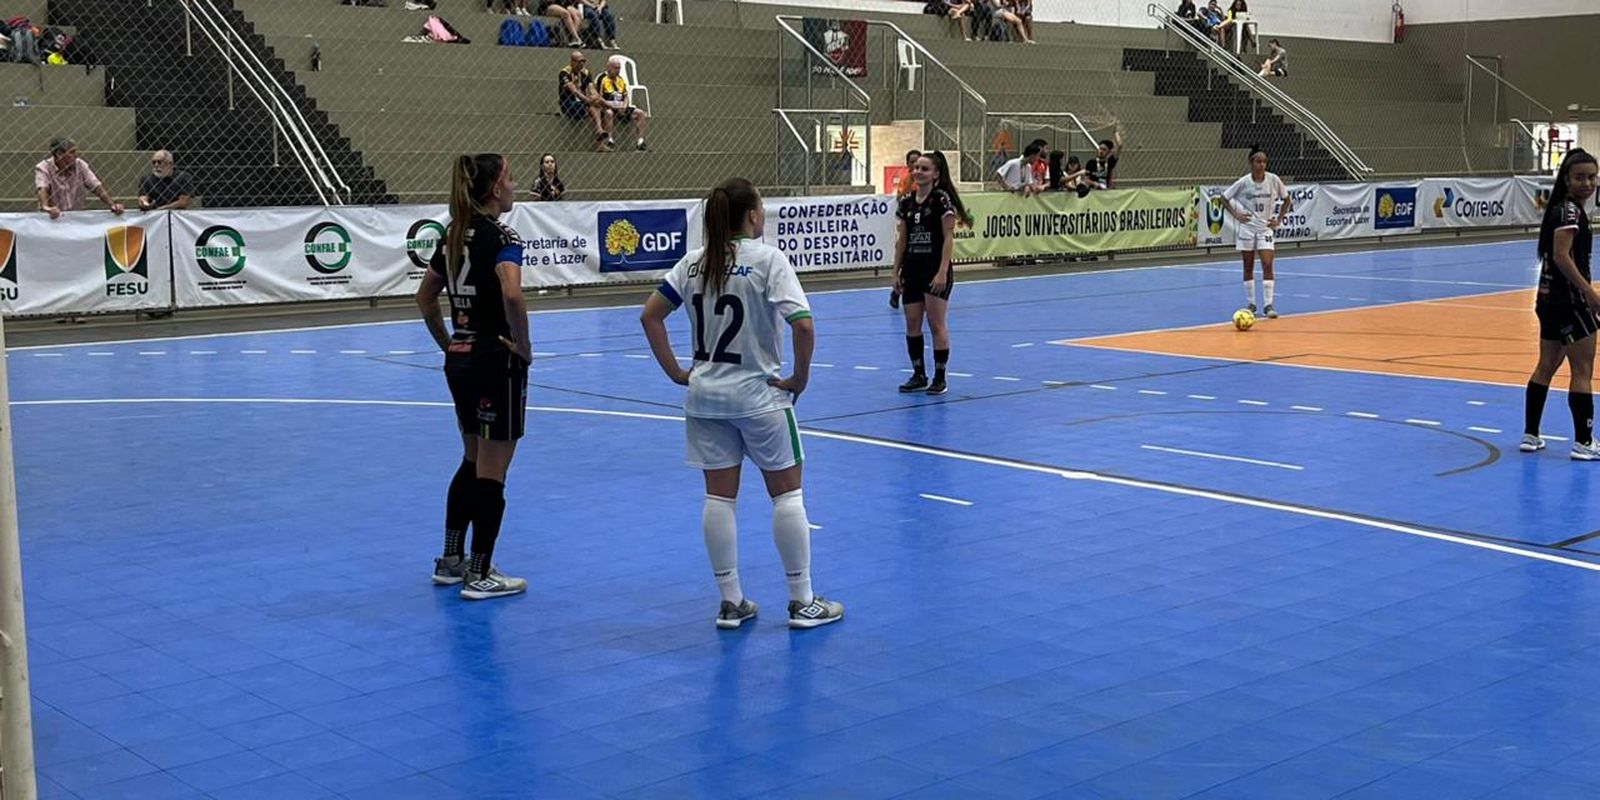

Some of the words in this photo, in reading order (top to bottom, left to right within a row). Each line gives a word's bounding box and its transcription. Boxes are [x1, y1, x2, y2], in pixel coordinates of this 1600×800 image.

[778, 200, 888, 219] CONFEDERAÇÃO
[1394, 203, 1414, 217] GDF
[1455, 197, 1504, 218] Correios
[914, 212, 921, 224] 9
[983, 215, 1021, 239] JOGOS
[1025, 208, 1117, 237] UNIVERSITÁRIOS
[1119, 207, 1186, 232] BRASILEIROS
[777, 219, 859, 235] BRASILEIRA
[304, 242, 335, 254] CONFAE
[521, 236, 568, 250] cretaria
[572, 236, 587, 249] de
[642, 232, 682, 252] GDF
[778, 238, 798, 252] DO
[804, 233, 876, 250] DESPORTO
[195, 246, 229, 258] CONFAE
[542, 256, 549, 265] e
[554, 252, 587, 266] Lazer
[787, 246, 884, 267] NIVERSITÁRIO
[442, 244, 477, 296] 12
[106, 282, 149, 296] FESU
[692, 293, 745, 365] 12
